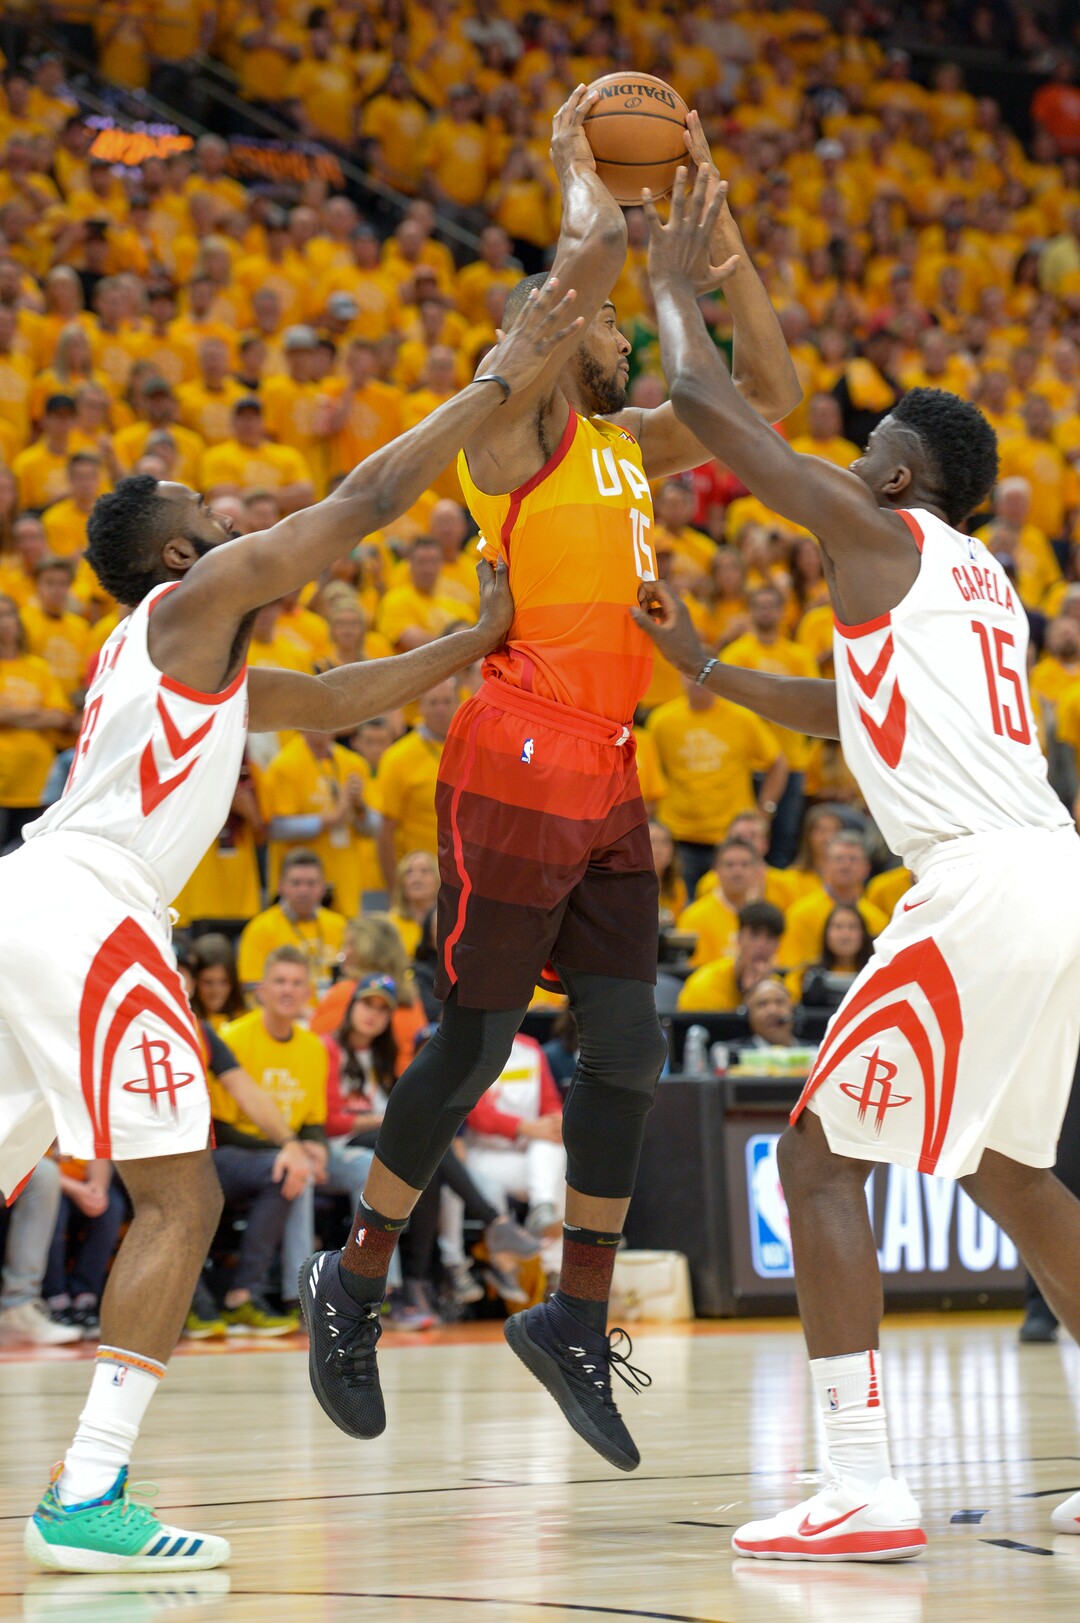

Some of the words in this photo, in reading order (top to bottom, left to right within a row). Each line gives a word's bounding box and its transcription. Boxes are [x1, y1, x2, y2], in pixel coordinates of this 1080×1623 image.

[600, 84, 676, 110] SPALDIN
[629, 507, 657, 582] 15
[952, 565, 1016, 616] CAPELA
[971, 620, 1031, 746] 15
[864, 1163, 1018, 1273] AYO
